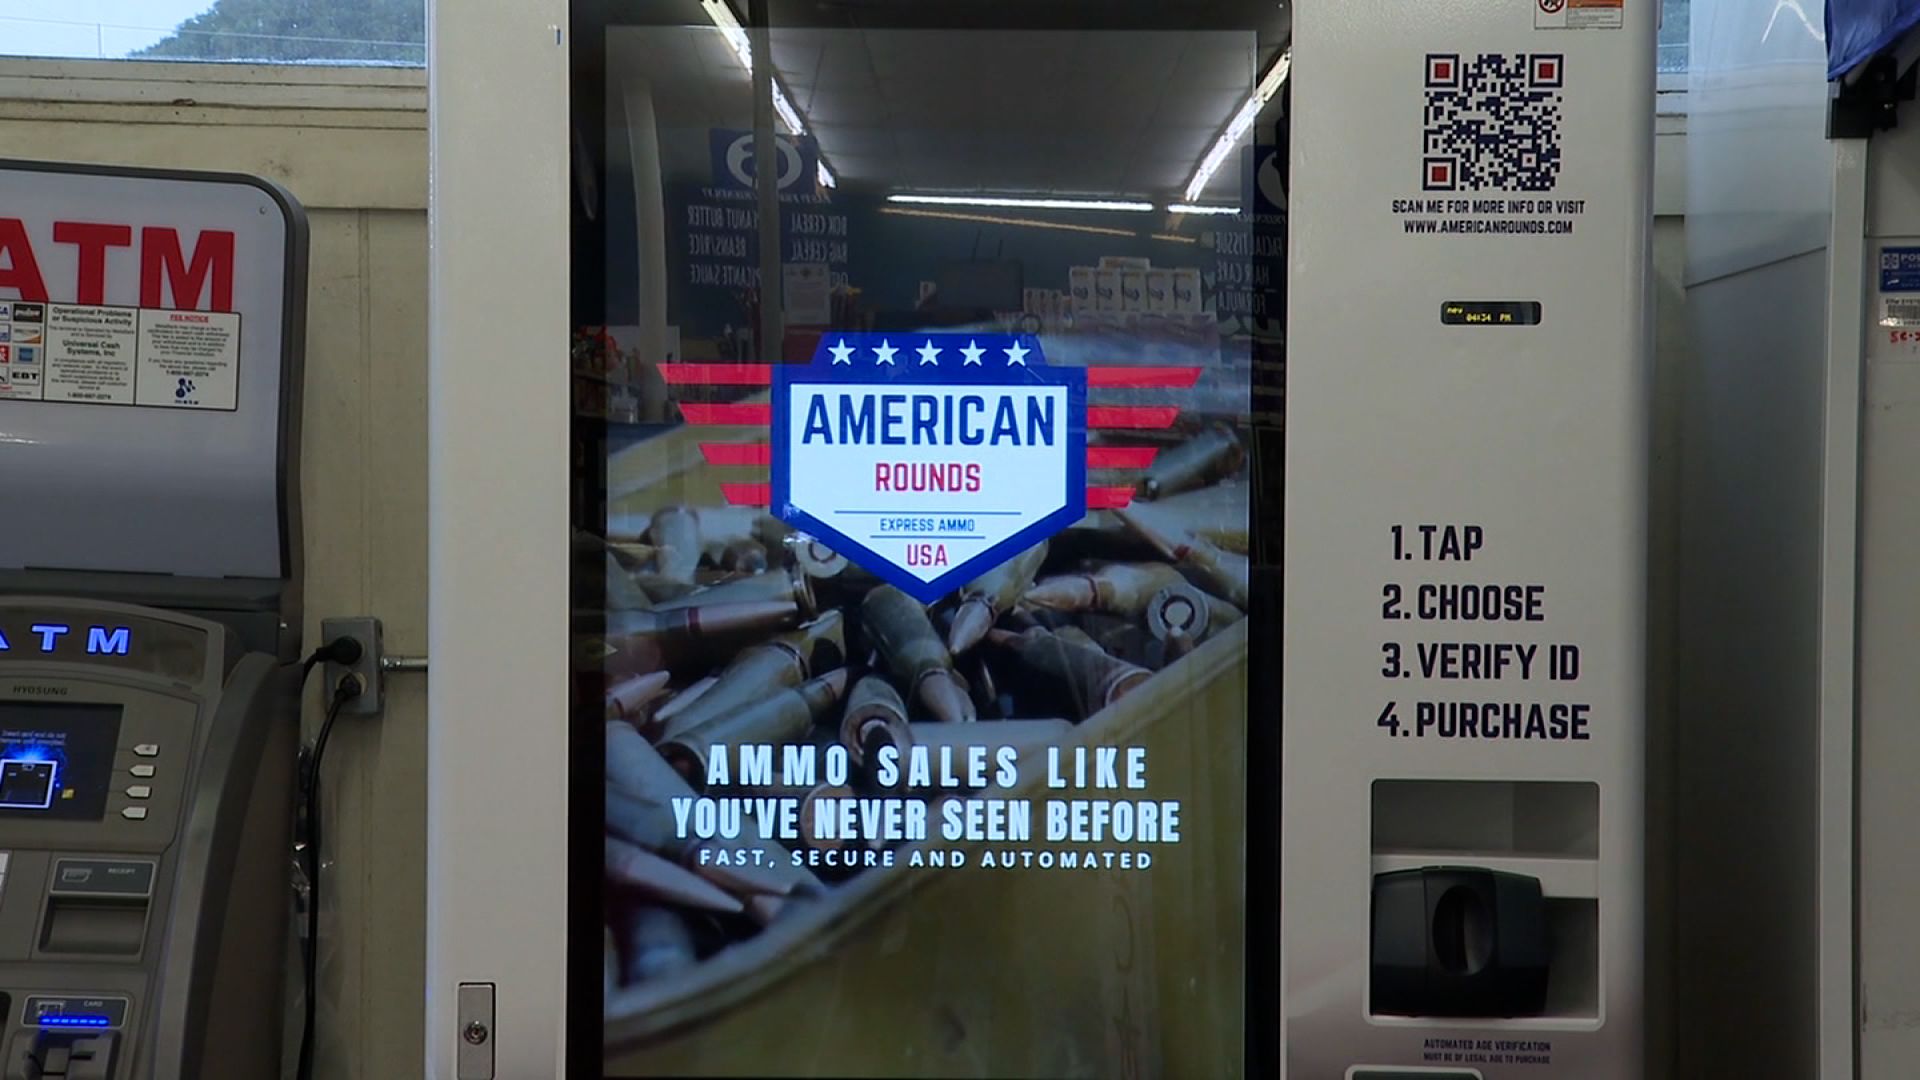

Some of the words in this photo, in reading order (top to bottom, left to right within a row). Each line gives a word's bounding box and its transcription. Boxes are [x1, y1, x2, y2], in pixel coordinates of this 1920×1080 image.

[1391, 200, 1423, 213] SCAN
[1426, 200, 1444, 213] ME
[1447, 200, 1469, 213] FOR
[1472, 200, 1505, 213] MORE
[1507, 200, 1534, 214] INFO
[1537, 200, 1553, 214] OR
[1556, 200, 1585, 214] VISIT
[1403, 219, 1573, 234] WWW.AMERICANROUNDS.COM
[802, 393, 1055, 447] AMERICAN
[875, 463, 981, 492] ROUNDS
[880, 518, 934, 531] EXPRESS
[938, 518, 975, 532] AMMO
[907, 544, 948, 566] USA
[1549, 644, 1579, 681] ID
[707, 744, 849, 786] AMMO
[877, 745, 1017, 788] SALES
[1047, 747, 1146, 789] LIKE
[671, 798, 798, 839] YOU'VE
[814, 799, 927, 840] NEVER
[942, 799, 1030, 841] SEEN
[1046, 800, 1180, 842] BEFORE
[700, 850, 776, 868] FAST,
[791, 850, 895, 867] SECURE
[909, 851, 965, 868] AND
[980, 851, 1152, 869] AUTOMATED
[1423, 1038, 1473, 1049] AUTOMATED
[1475, 1040, 1493, 1050] AGE
[1494, 1040, 1551, 1052] VERIFICATION
